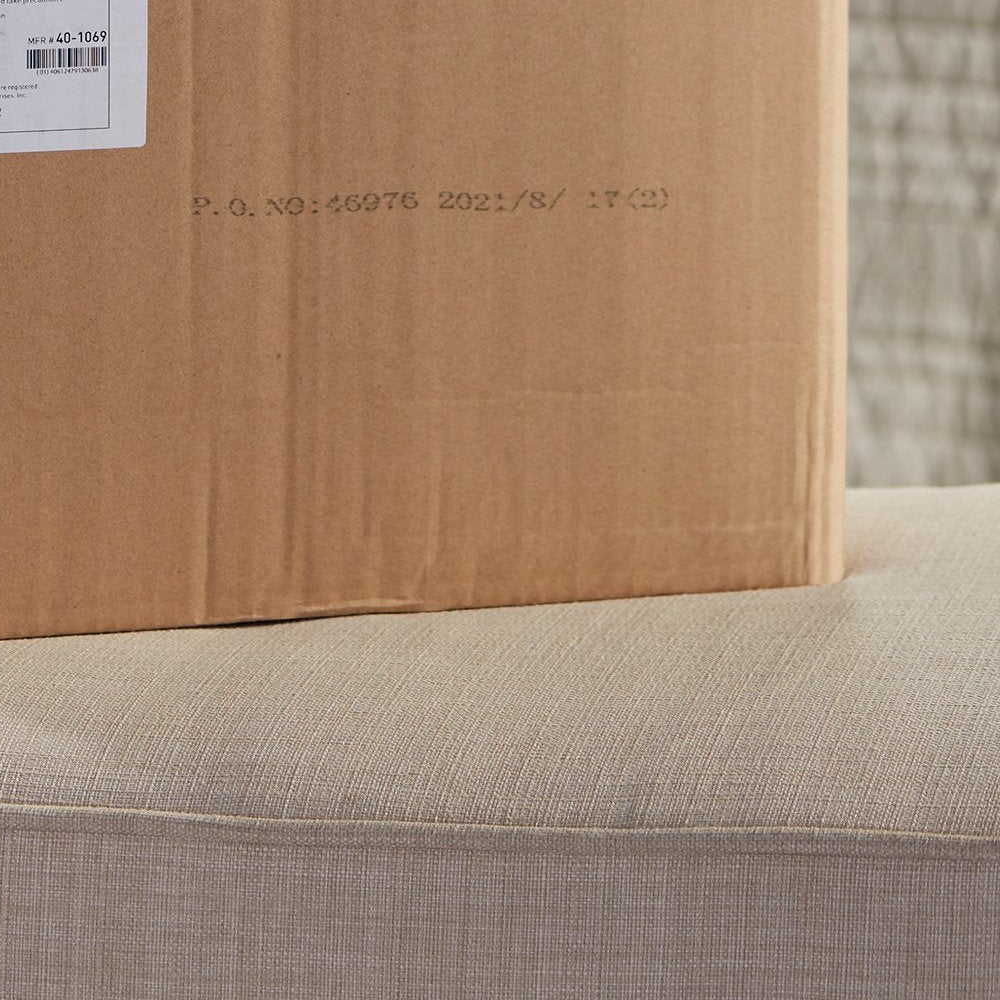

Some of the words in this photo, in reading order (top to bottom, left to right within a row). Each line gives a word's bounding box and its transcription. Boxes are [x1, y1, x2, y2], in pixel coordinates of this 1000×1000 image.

[28, 36, 46, 44] MFR
[56, 30, 107, 44] 40-1069
[8, 84, 38, 92] registered
